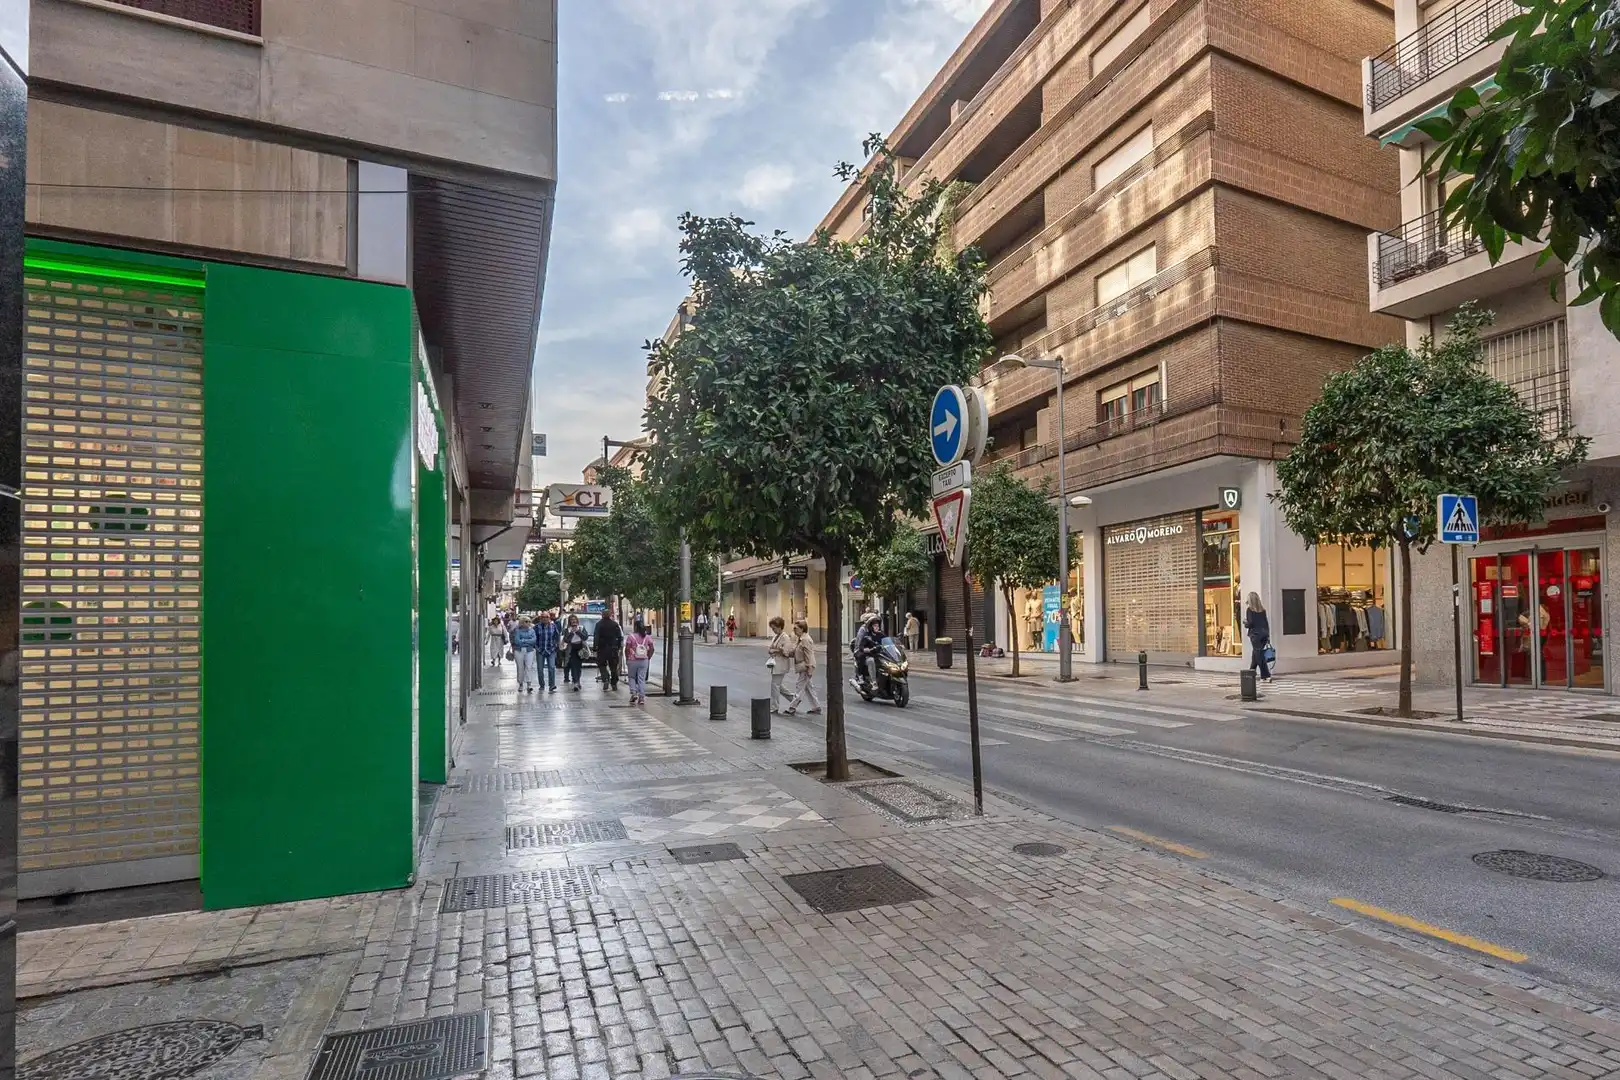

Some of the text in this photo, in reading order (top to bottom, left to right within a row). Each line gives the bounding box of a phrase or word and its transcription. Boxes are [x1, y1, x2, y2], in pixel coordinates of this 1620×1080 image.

[938, 468, 957, 481] EXCEPTO
[942, 478, 952, 488] TAXI
[575, 491, 609, 507] CL
[1107, 533, 1135, 545] ALVARO
[1147, 525, 1182, 538] MORENO
